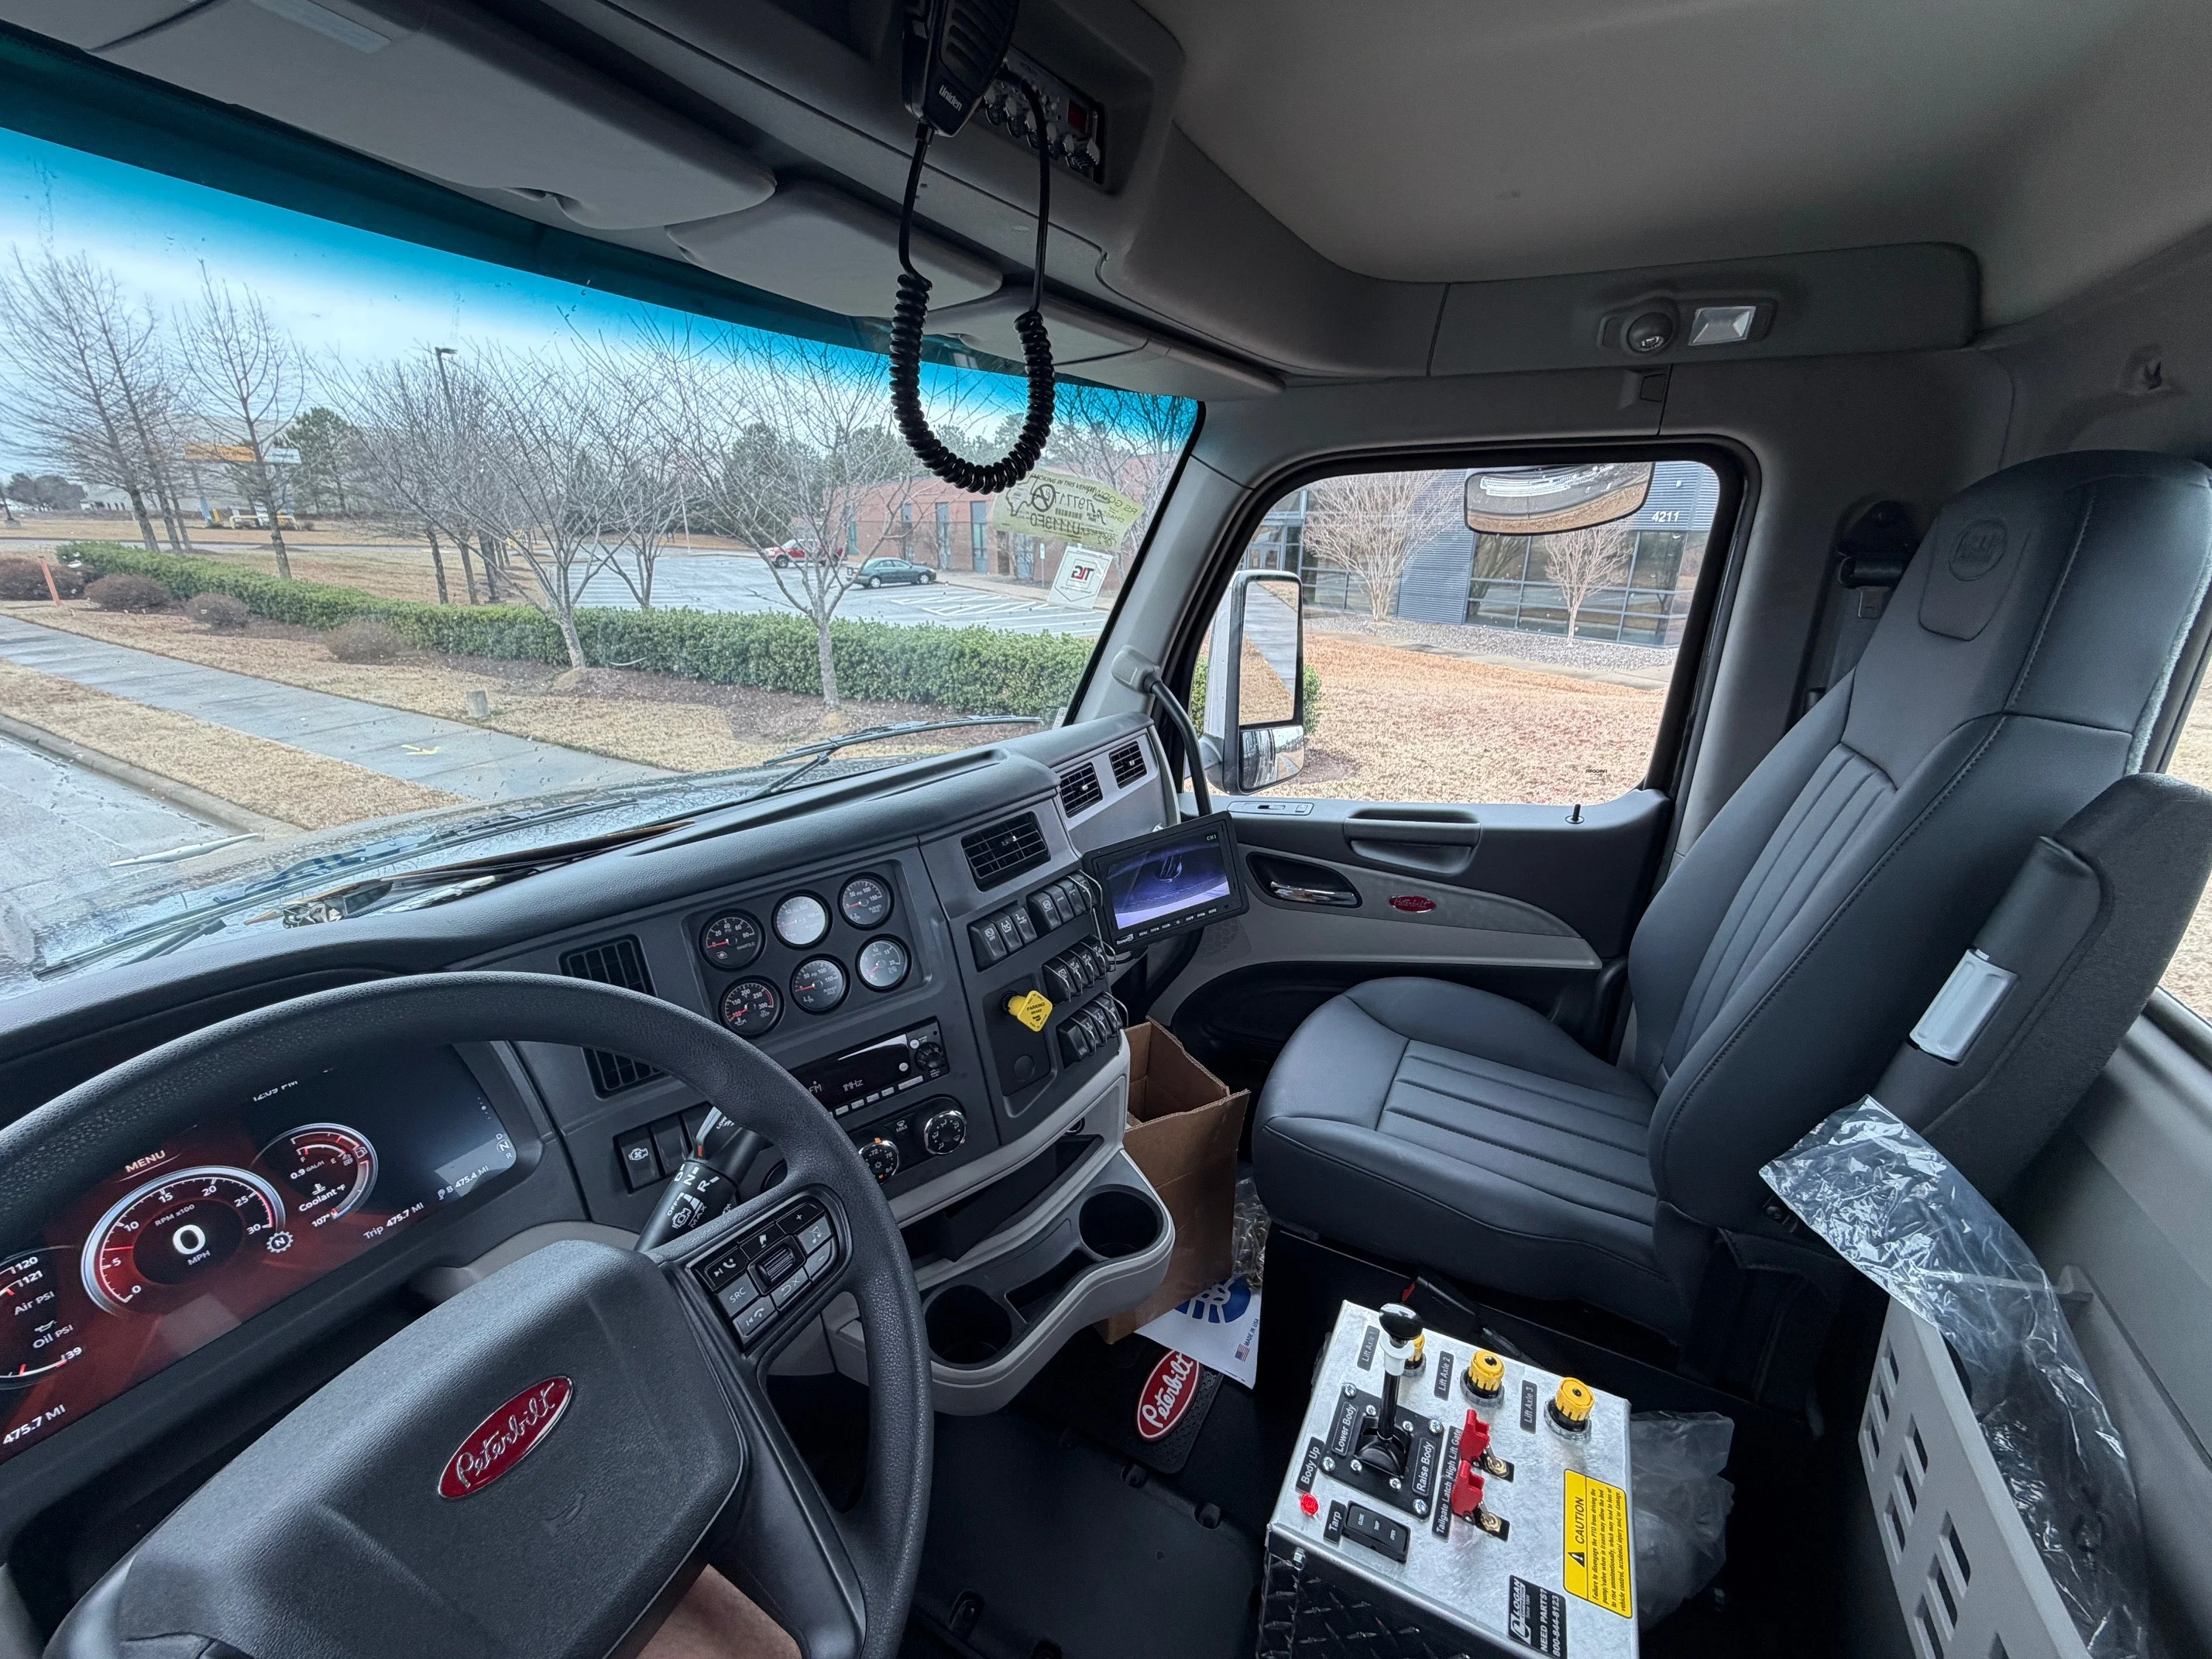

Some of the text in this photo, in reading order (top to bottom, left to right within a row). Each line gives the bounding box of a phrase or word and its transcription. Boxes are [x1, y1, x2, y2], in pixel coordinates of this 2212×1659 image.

[938, 84, 963, 112] Uniden
[1651, 510, 1679, 523] 4211
[1394, 898, 1431, 908] Peterbilt
[1026, 1002, 1046, 1012] PARKING
[125, 1149, 166, 1173] MENU
[290, 1168, 306, 1180] 0.9
[455, 1172, 477, 1188] 475.4
[478, 1165, 489, 1176] MI
[674, 1171, 684, 1182] D
[683, 1173, 696, 1186] N
[201, 1185, 217, 1197] 20
[697, 1180, 710, 1193] R
[159, 1192, 173, 1203] 15
[234, 1197, 249, 1207] 25
[298, 1188, 337, 1212] Coolant
[154, 1204, 196, 1227] RPM x100
[363, 1201, 424, 1239] Trip 475.7 MI
[124, 1221, 139, 1232] 10
[246, 1223, 261, 1235] 30
[173, 1224, 205, 1255] 0
[274, 1237, 286, 1247] N
[15, 1256, 38, 1270] 120
[112, 1257, 122, 1266] 5
[187, 1249, 211, 1266] MPH
[22, 1270, 43, 1283] 121
[132, 1285, 142, 1294] 0
[730, 1286, 746, 1304] SRC
[15, 1291, 55, 1316] Air PSI
[33, 1324, 74, 1349] Oil PSI
[1244, 1332, 1254, 1347] MADE
[1366, 1337, 1375, 1350] Axle
[66, 1347, 82, 1360] 39
[1362, 1349, 1371, 1362] Lift
[1441, 1363, 1450, 1378] Axle
[1142, 1352, 1194, 1428] Peterbilt
[1438, 1377, 1448, 1391] Lift
[2, 1404, 66, 1444] 475.7 MI
[1524, 1409, 1533, 1424] Lift
[456, 1382, 555, 1489] Peterbilt
[1335, 1404, 1356, 1452] Lower Body
[1445, 1428, 1462, 1481] High Lift Gate
[1301, 1447, 1321, 1485] Body Up
[1417, 1441, 1435, 1492] Raise Body
[1436, 1478, 1453, 1534] Tailgate Latch
[1329, 1510, 1342, 1532] Tarp
[1575, 1496, 1585, 1544] CAUTION
[1540, 1588, 1548, 1652] NEED PARTS?
[1551, 1595, 1561, 1657] 800-844-8123
